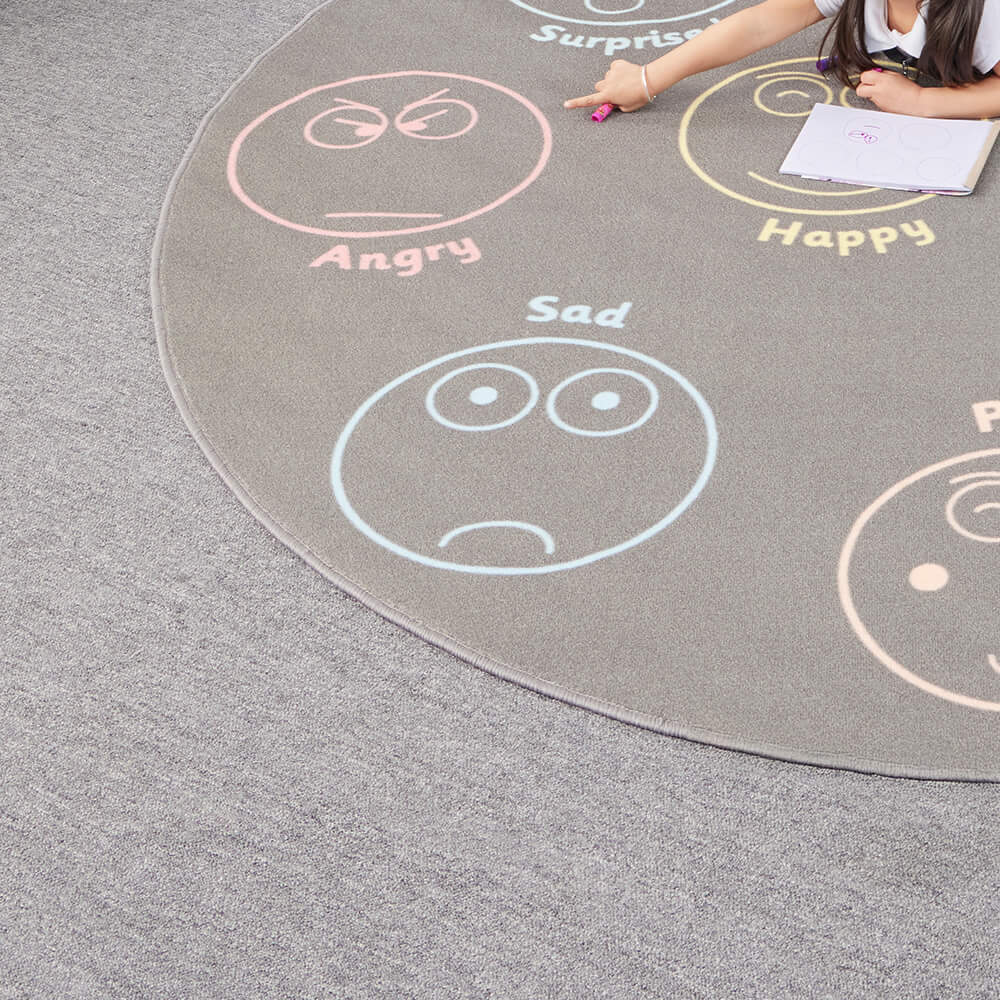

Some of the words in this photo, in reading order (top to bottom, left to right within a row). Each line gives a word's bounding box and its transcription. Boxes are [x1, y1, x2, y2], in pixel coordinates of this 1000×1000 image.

[756, 217, 936, 256] Happy
[309, 237, 482, 277] Angry
[525, 295, 633, 329] Sad
